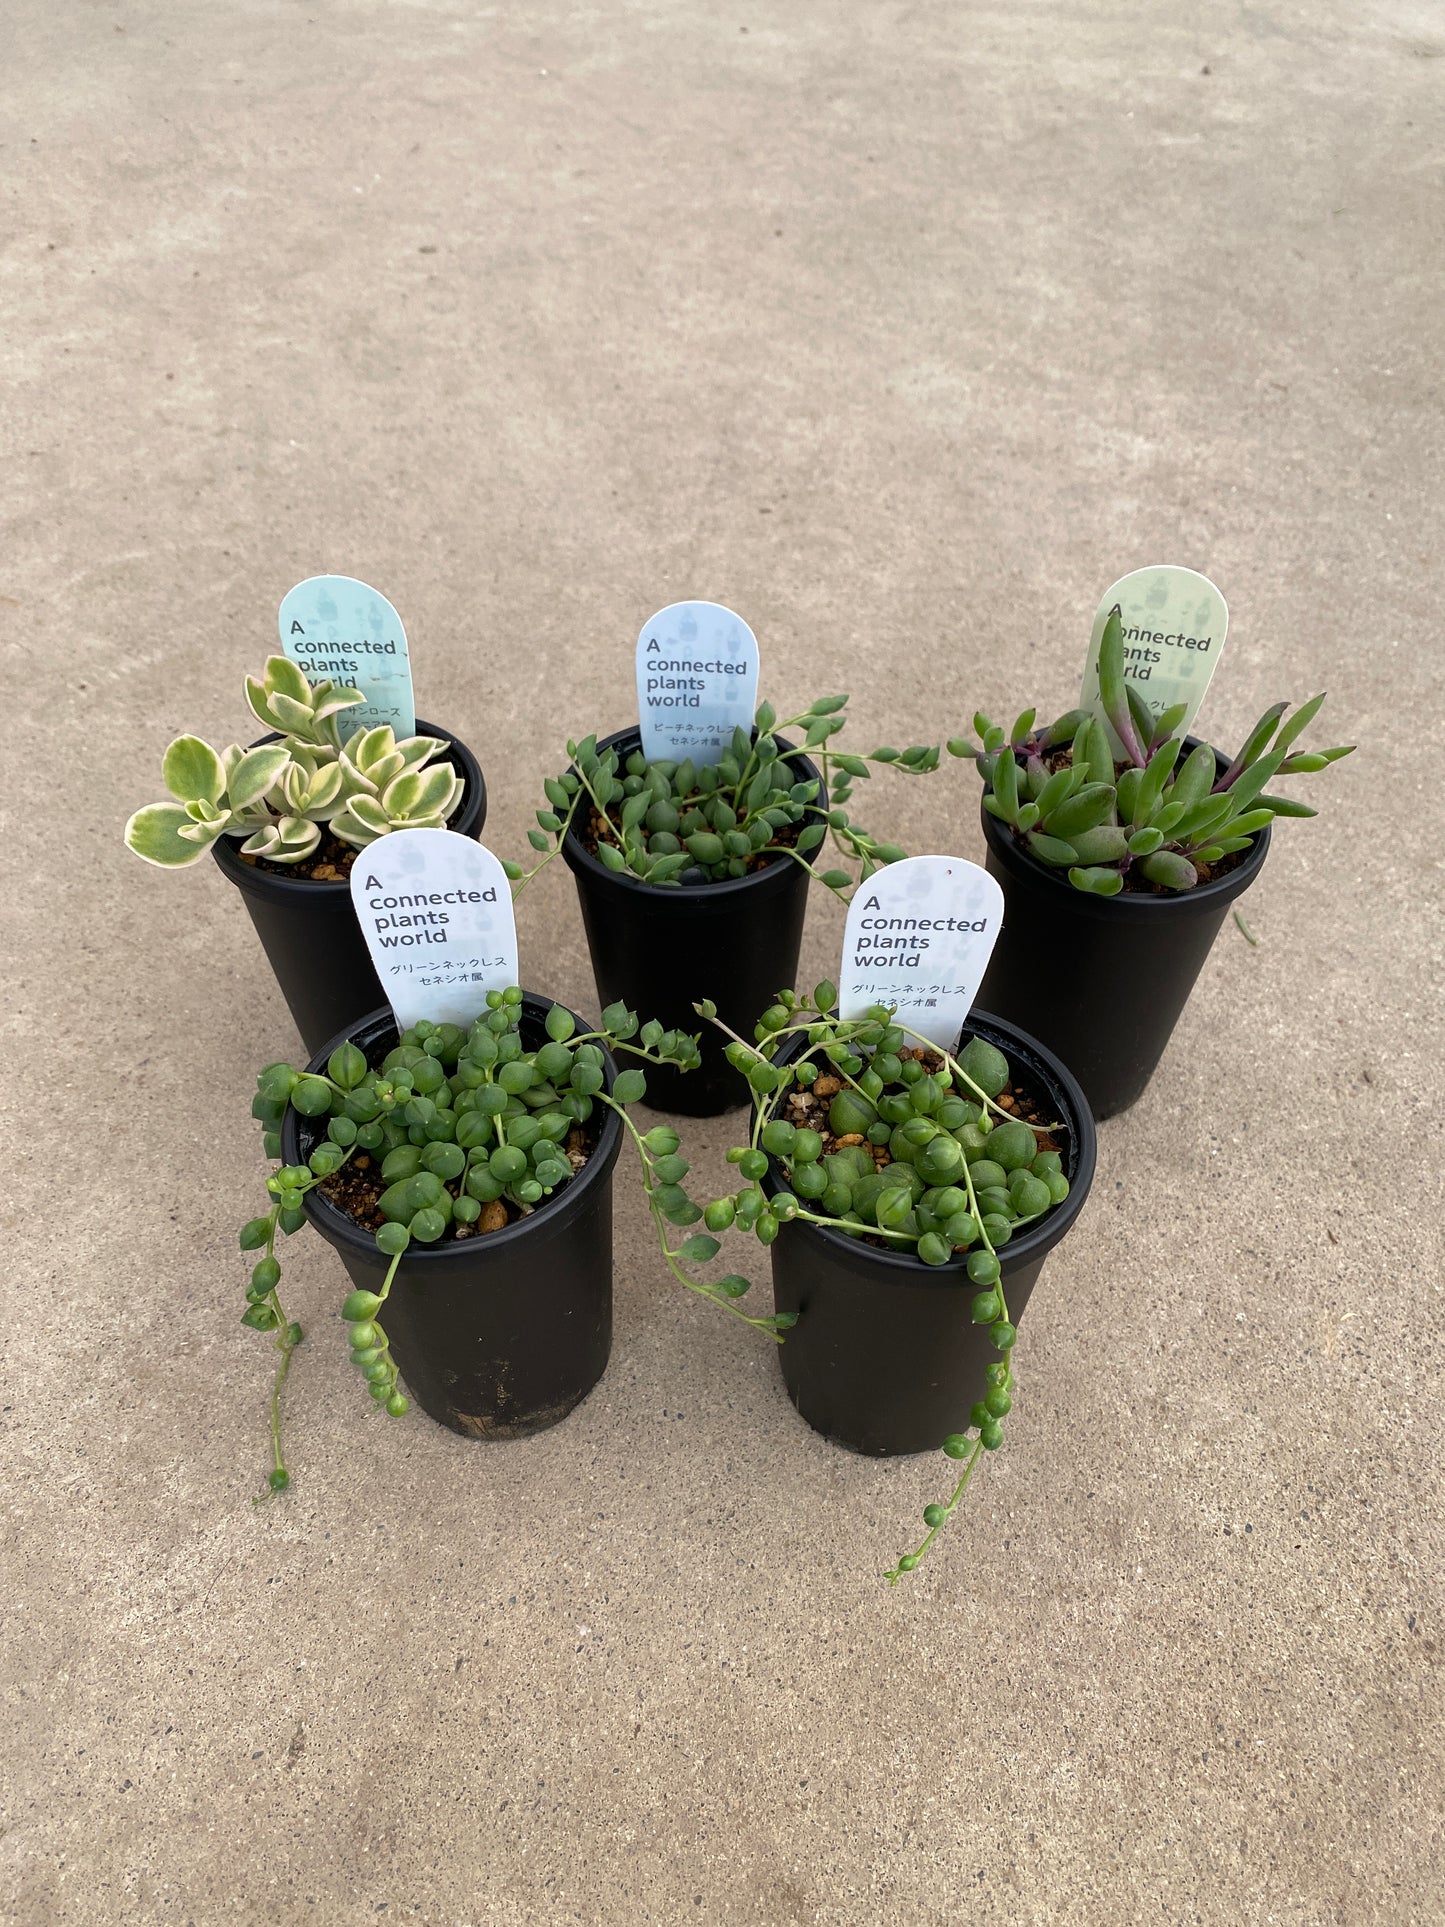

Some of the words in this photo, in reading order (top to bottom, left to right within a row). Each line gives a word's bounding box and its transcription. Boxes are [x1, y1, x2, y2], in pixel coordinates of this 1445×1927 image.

[1107, 603, 1122, 618] A
[290, 620, 305, 635] A
[646, 638, 661, 652] A
[1121, 626, 1212, 652] onnected
[294, 640, 396, 654] connected
[1123, 647, 1162, 663] ants
[298, 657, 358, 672] plants
[646, 660, 747, 675] connected
[647, 676, 706, 692] plants
[646, 694, 700, 707] world
[365, 875, 383, 890] A
[369, 887, 497, 910] connected
[863, 896, 881, 911] A
[374, 910, 450, 934] plants
[860, 918, 988, 933] connected
[378, 928, 448, 948] world
[856, 934, 930, 952] plants
[389, 956, 508, 975] グリーンネックレス
[854, 953, 921, 968] world
[419, 972, 484, 986] セネシオ属
[851, 983, 967, 995] グリーンネックレス
